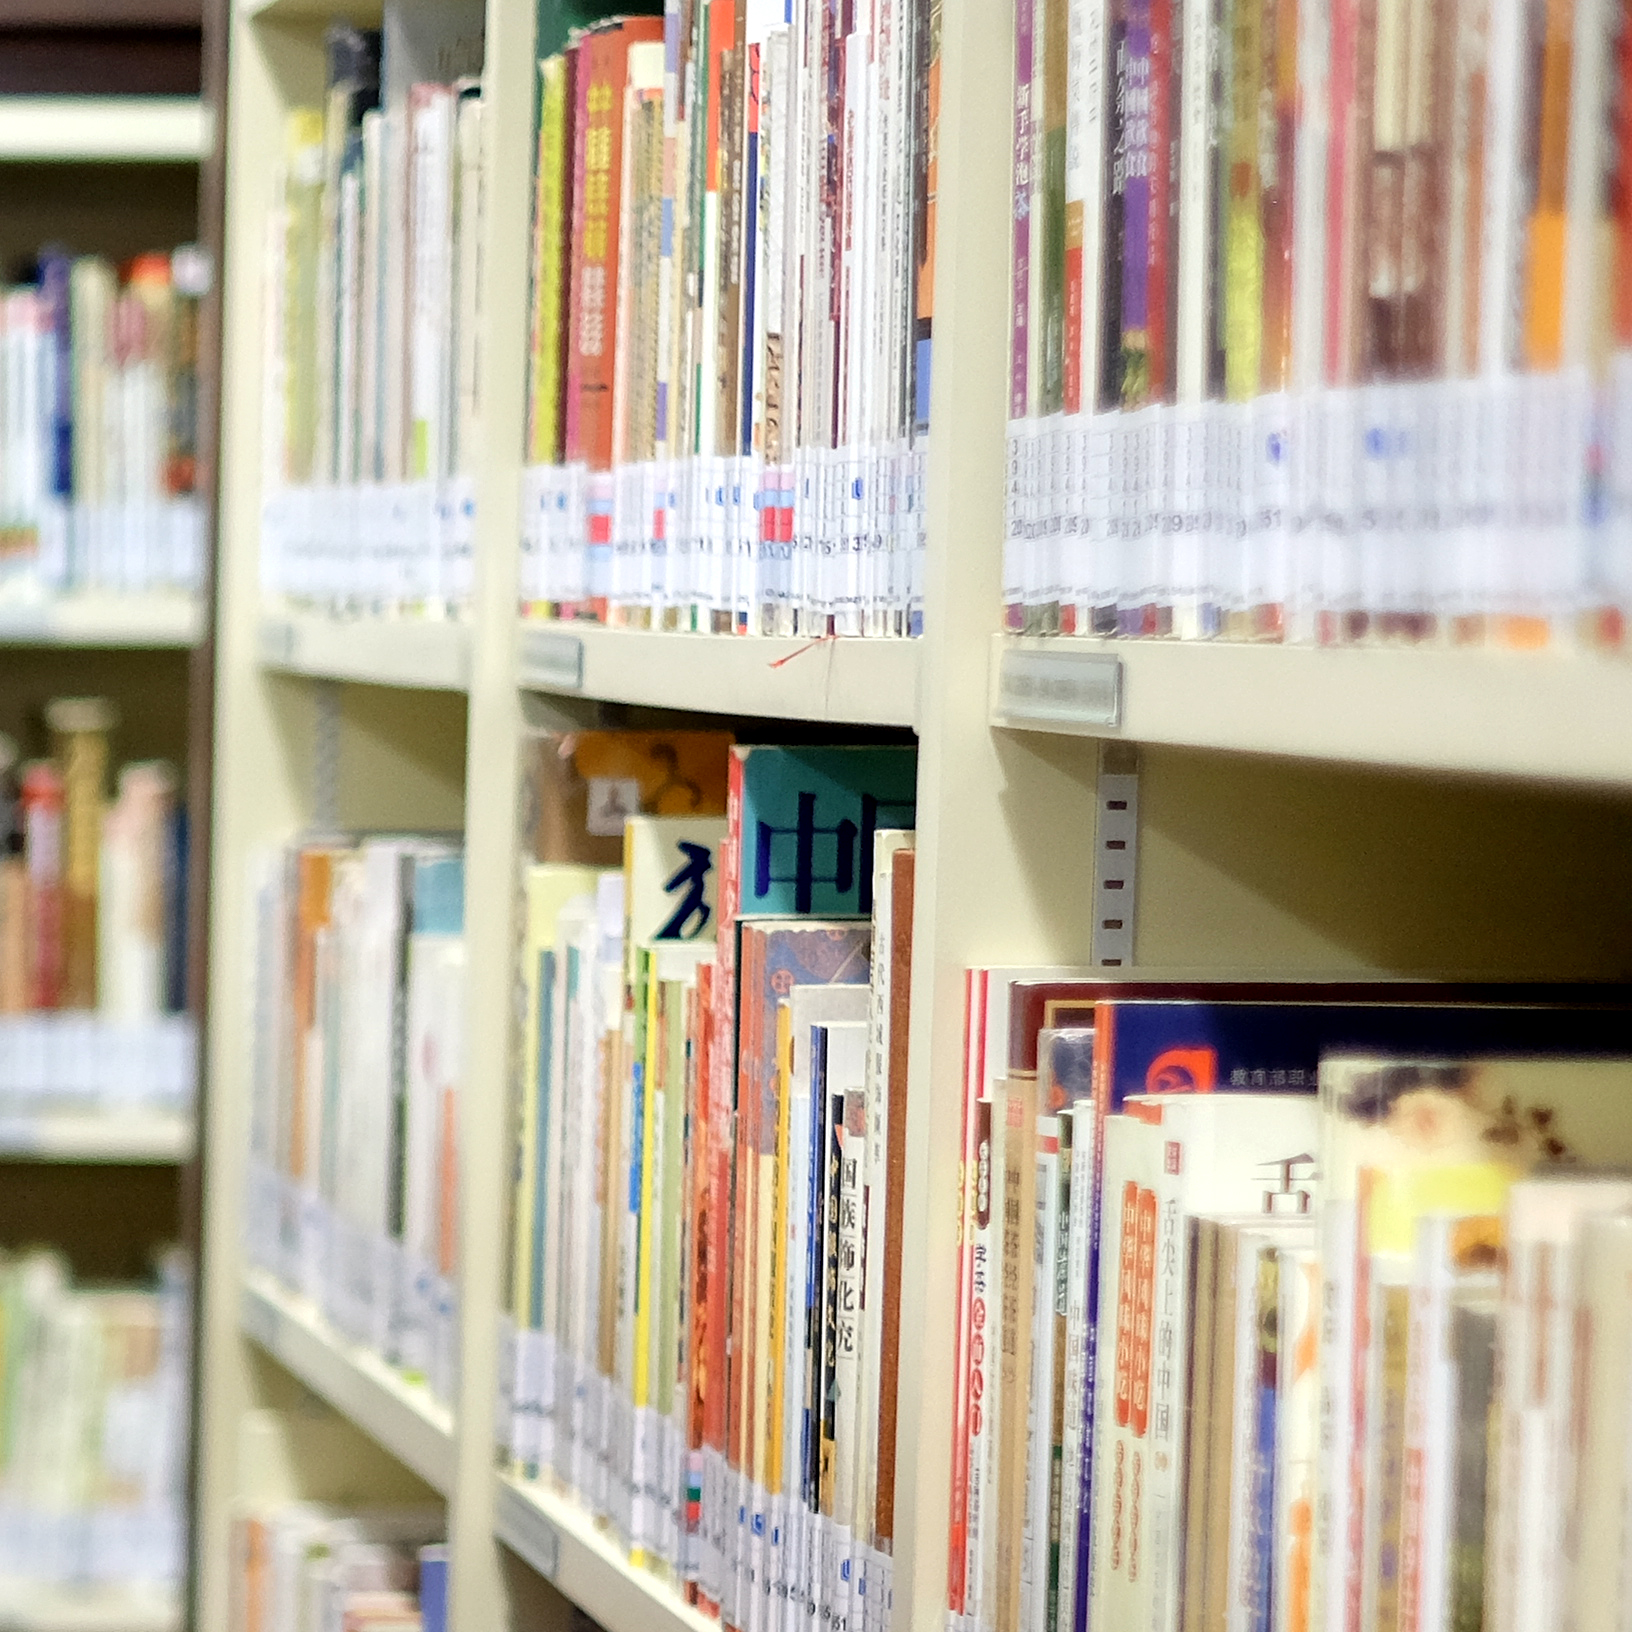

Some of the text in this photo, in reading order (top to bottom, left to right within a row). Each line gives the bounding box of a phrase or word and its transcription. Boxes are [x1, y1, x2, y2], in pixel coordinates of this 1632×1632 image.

[1156, 1197, 1177, 1442] 舌尖上的中国
